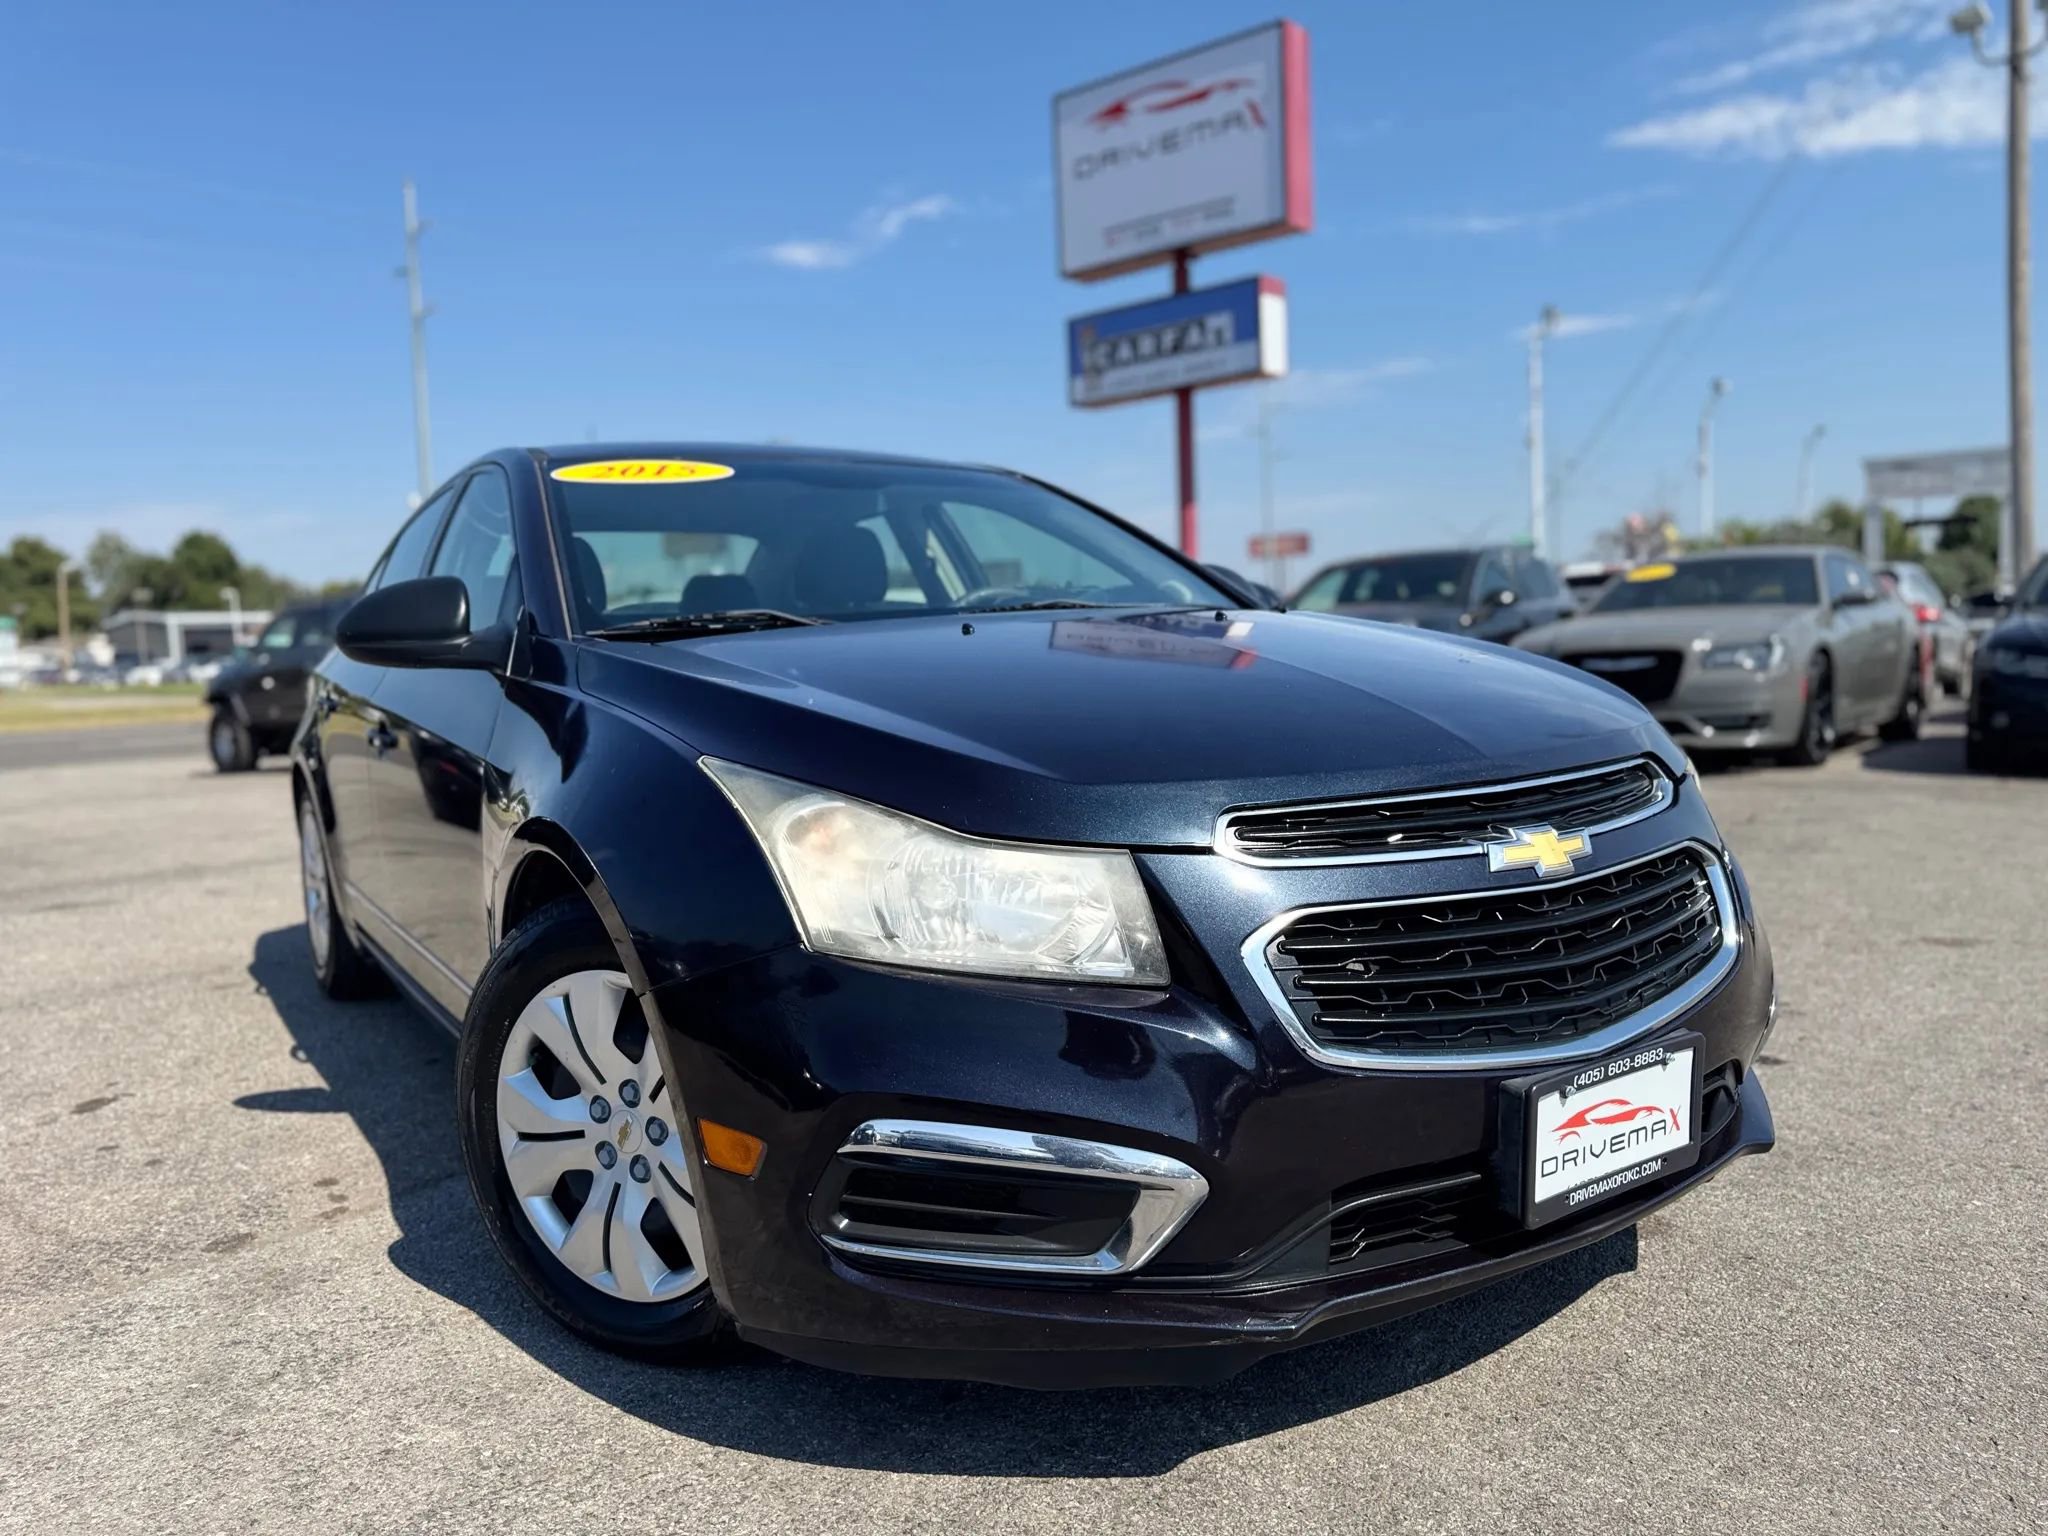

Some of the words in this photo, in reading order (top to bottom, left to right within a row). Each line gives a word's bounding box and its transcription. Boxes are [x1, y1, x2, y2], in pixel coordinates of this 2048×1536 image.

[1072, 98, 1266, 181] DRIVEMAX
[591, 463, 698, 480] 2015
[1573, 1066, 1605, 1088] (405)
[1607, 1047, 1664, 1077] 603-8883
[1541, 1104, 1682, 1178] DRIVEMAX
[1569, 1158, 1662, 1206] DRIVEMAXOFOKC.COM
